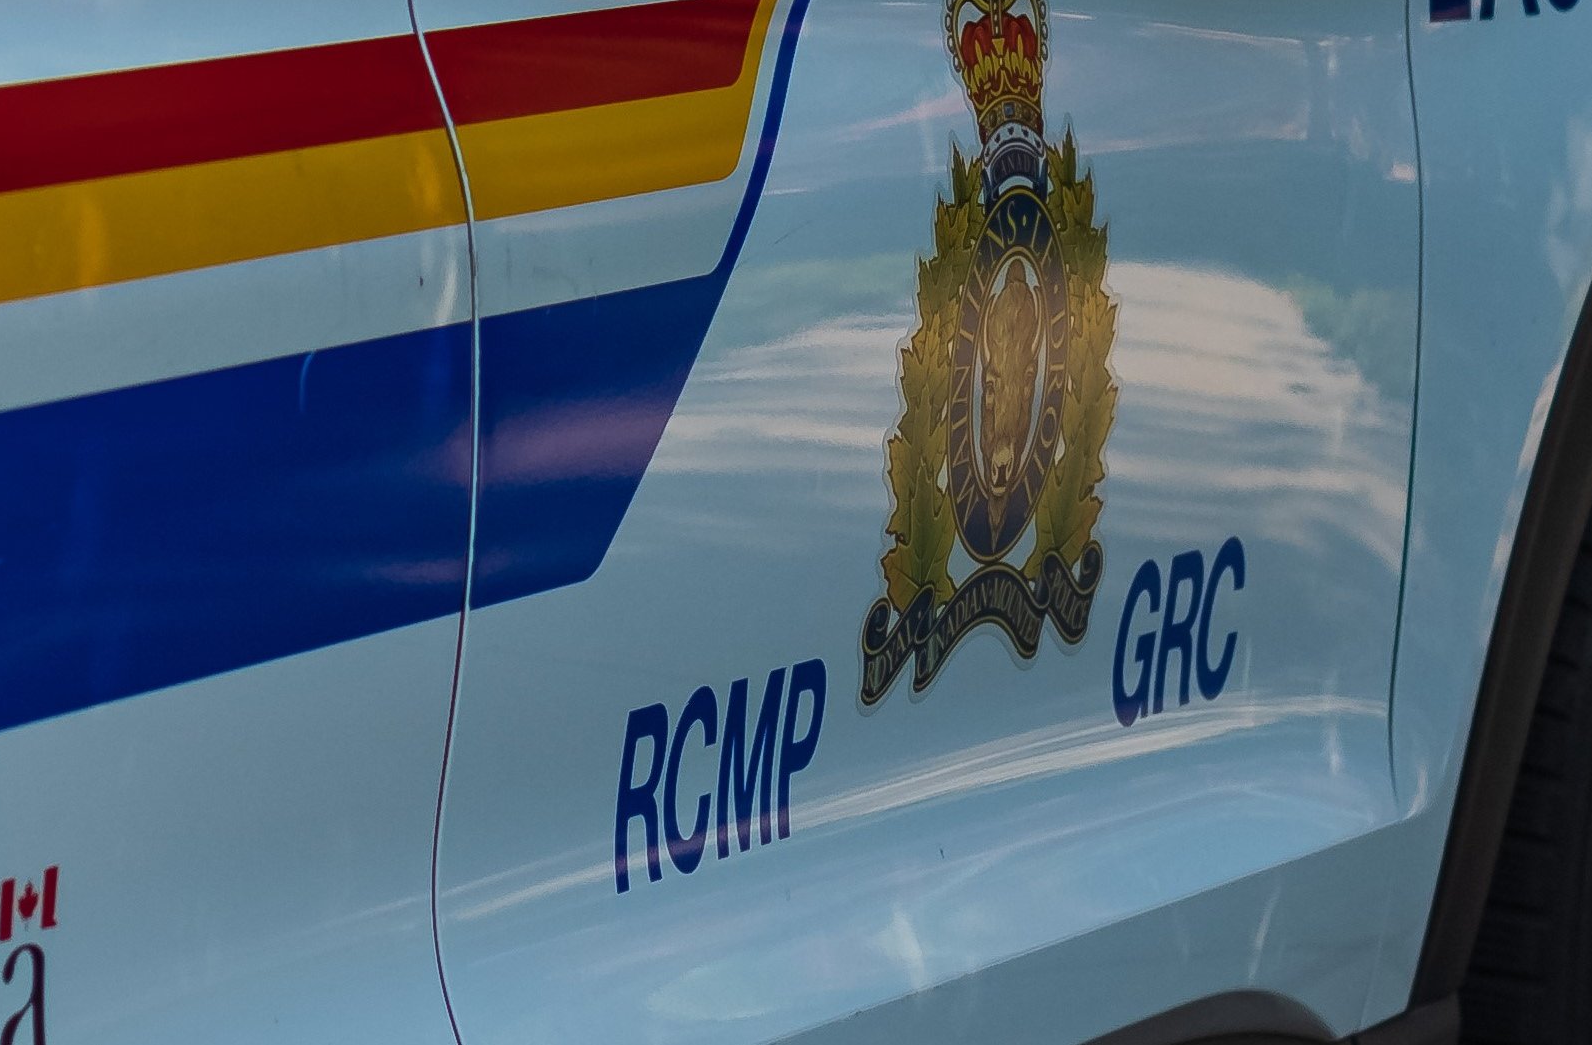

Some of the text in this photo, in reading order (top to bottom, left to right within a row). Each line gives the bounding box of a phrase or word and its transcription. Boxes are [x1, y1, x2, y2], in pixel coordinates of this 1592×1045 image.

[866, 567, 1089, 694] ROYAL CANADIAN MOUNTED POLICE
[1111, 535, 1246, 728] GRC
[614, 657, 827, 895] RCMP
